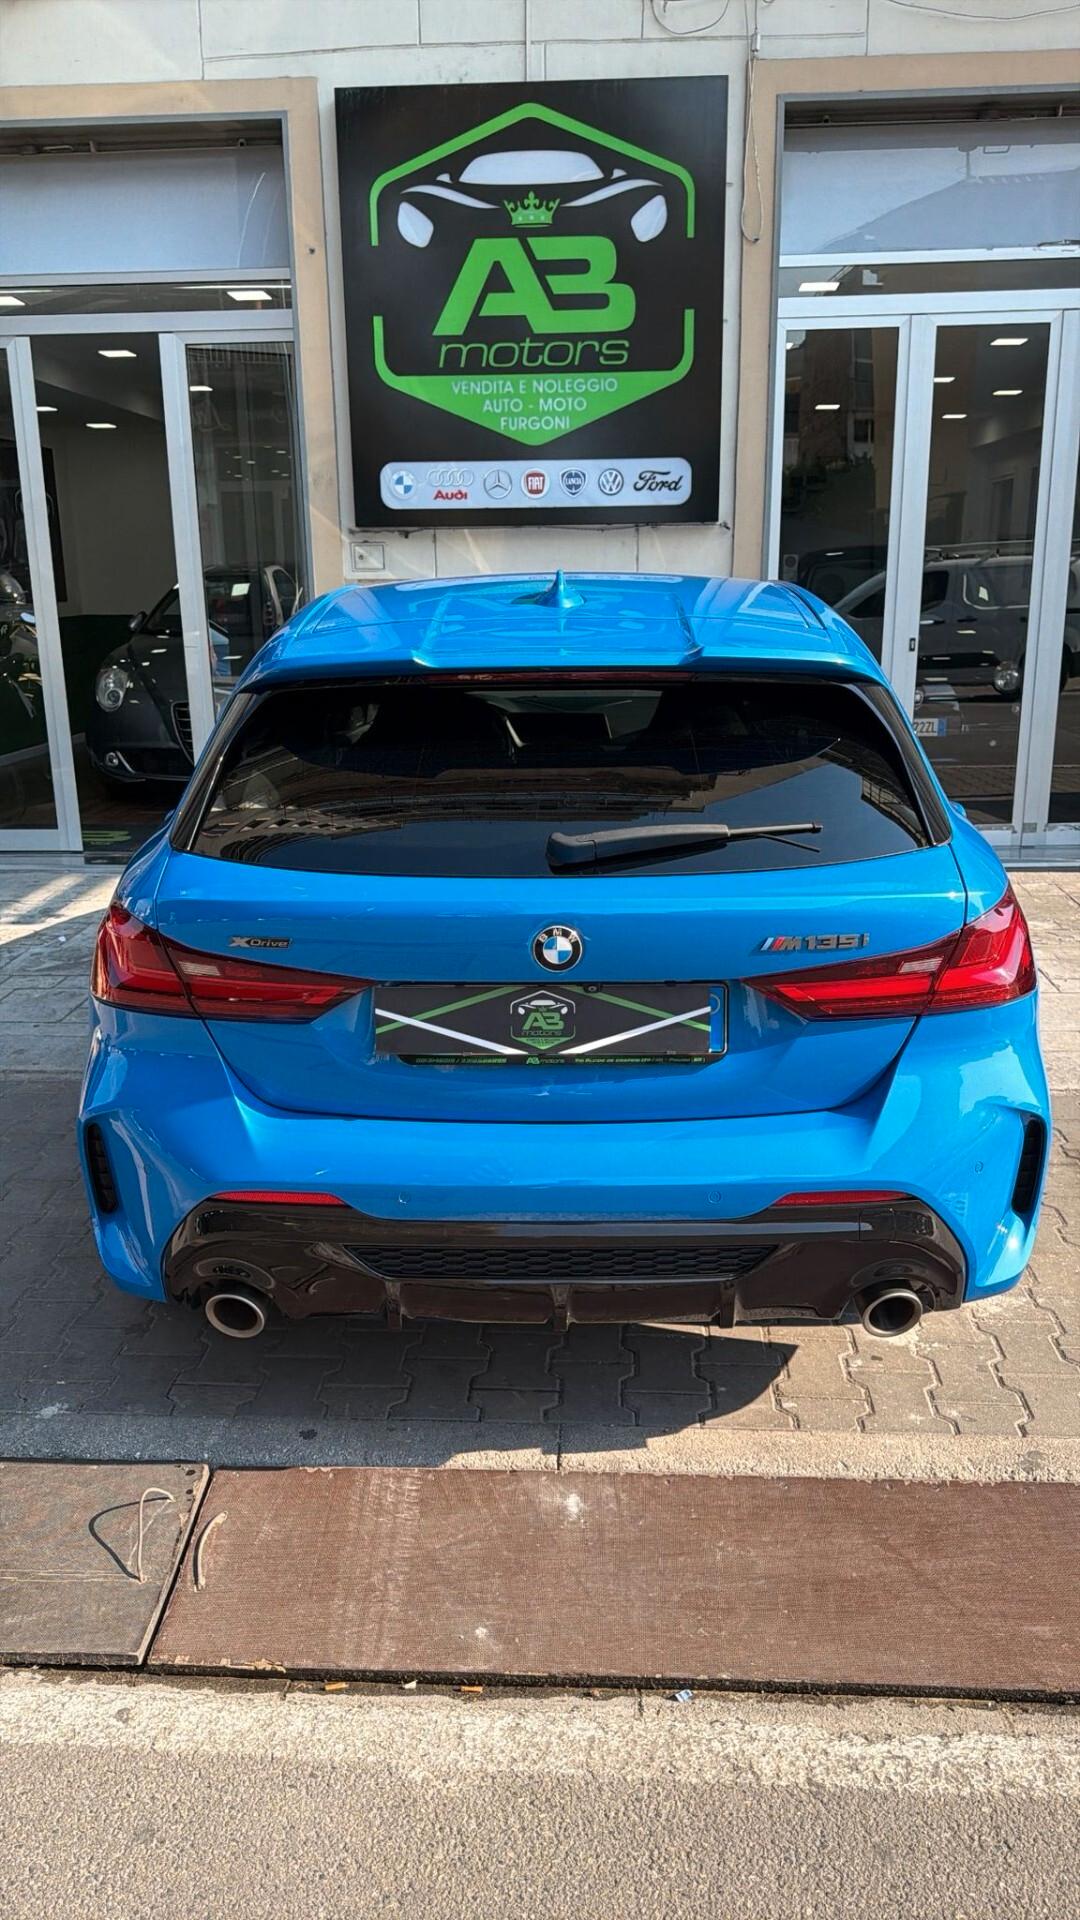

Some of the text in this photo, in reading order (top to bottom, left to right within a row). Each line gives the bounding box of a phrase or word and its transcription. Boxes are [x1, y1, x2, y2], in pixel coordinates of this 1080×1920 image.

[432, 236, 636, 336] AB
[438, 338, 630, 368] motors
[452, 378, 618, 394] VENDITA E NOLEGGIO
[483, 398, 523, 413] AUTO
[539, 397, 587, 412] MOTO
[501, 416, 570, 430] FURGONI
[527, 476, 544, 491] FIAT
[633, 470, 684, 491] Ford
[434, 490, 468, 500] Audi
[538, 928, 578, 943] BMW
[766, 932, 870, 951] M135i
[522, 1012, 565, 1030] AB
